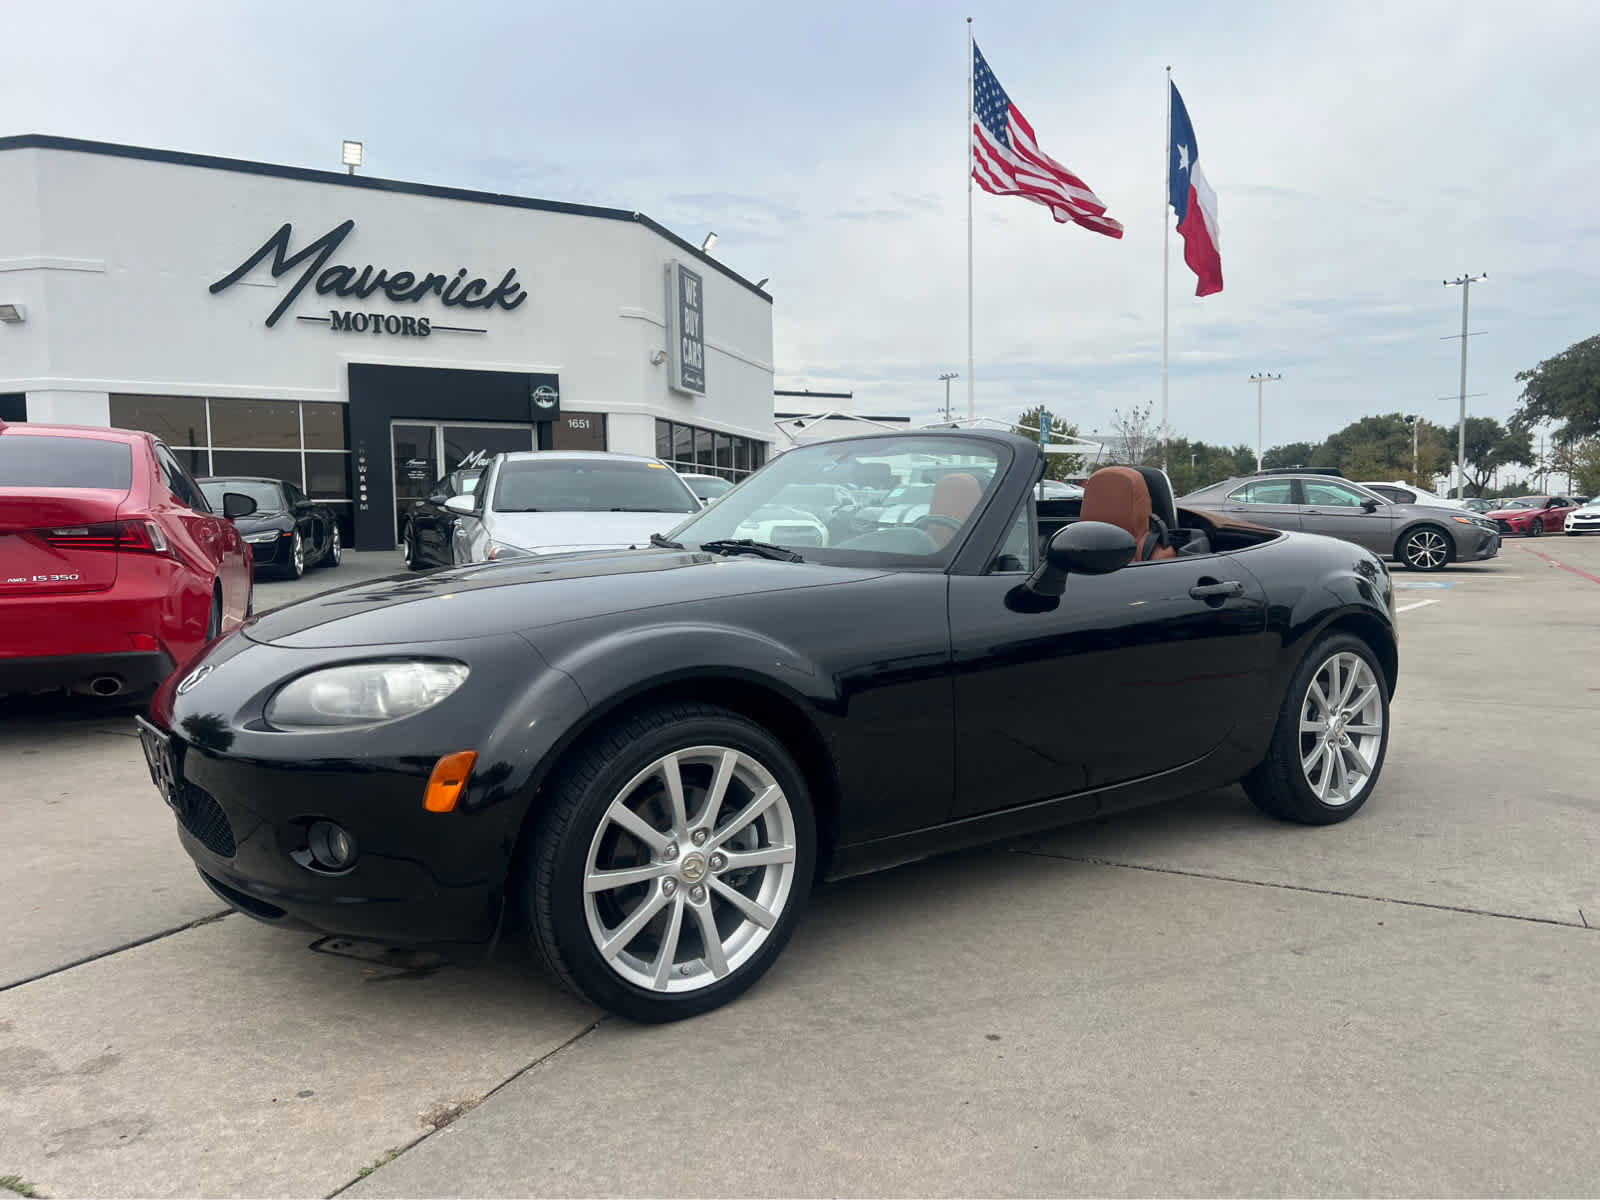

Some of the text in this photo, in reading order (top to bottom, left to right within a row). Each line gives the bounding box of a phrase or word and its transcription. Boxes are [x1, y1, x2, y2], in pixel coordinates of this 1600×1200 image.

[209, 219, 527, 328] Maverick
[684, 276, 698, 308] WE
[330, 310, 431, 336] MOTORS
[684, 306, 699, 338] BUY
[682, 337, 702, 369] CARS
[567, 418, 590, 429] 1651
[49, 573, 79, 581] 350
